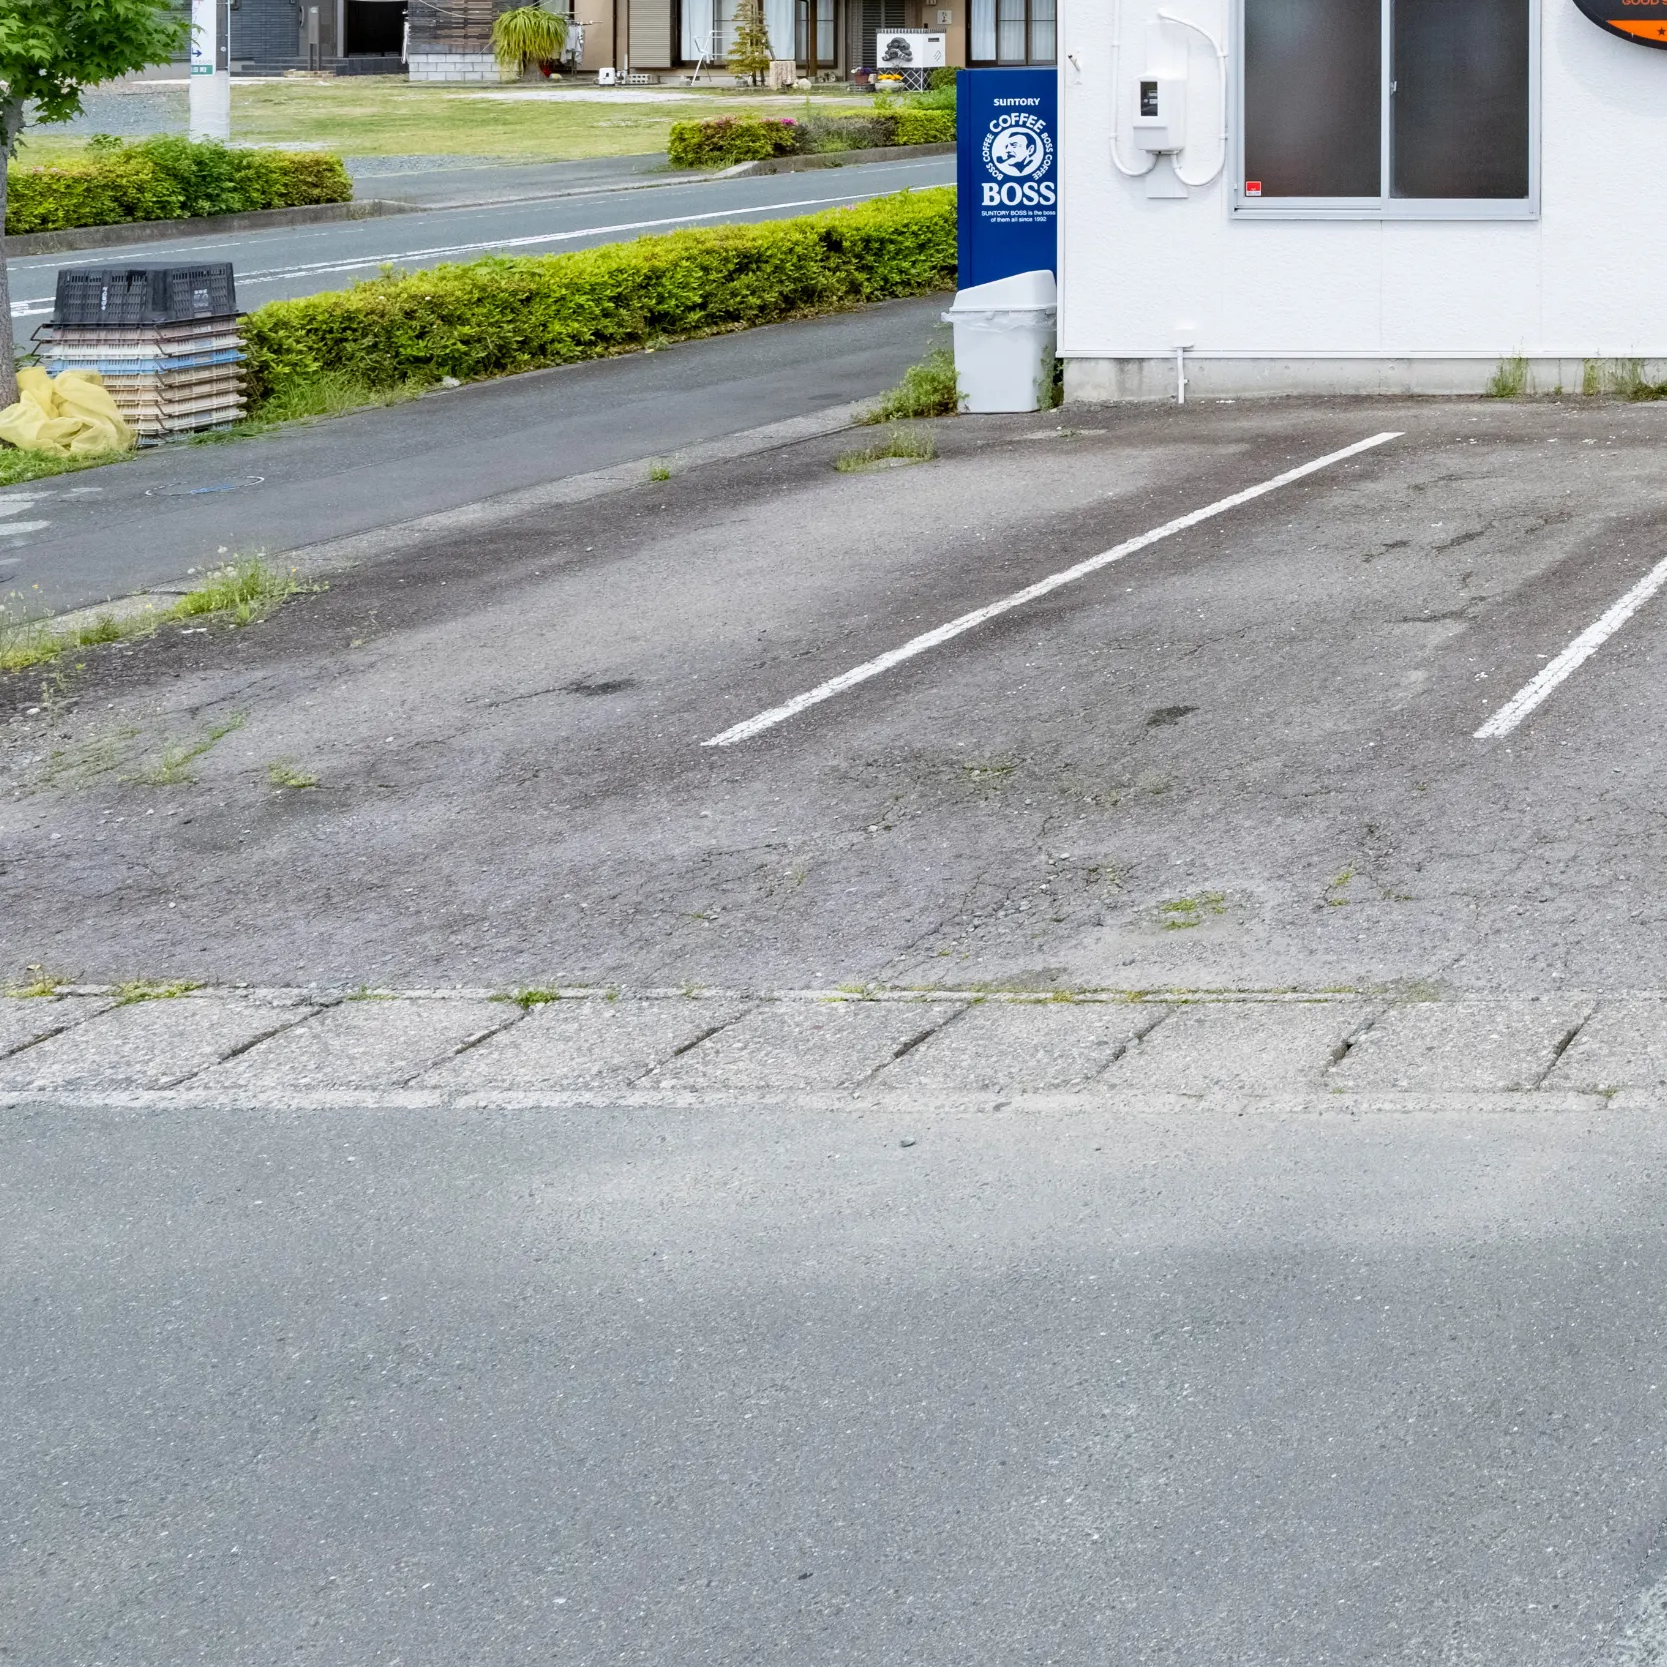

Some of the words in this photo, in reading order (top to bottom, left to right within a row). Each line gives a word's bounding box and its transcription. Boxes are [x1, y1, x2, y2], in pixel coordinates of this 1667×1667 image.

[993, 98, 1041, 106] SUNTORY
[989, 113, 1047, 133] COFFEE
[982, 133, 994, 162] COFFEE
[1041, 132, 1054, 153] BOSS
[986, 163, 1003, 180] BOSS
[1032, 154, 1053, 180] COFFEE
[981, 181, 1056, 206] BOSS
